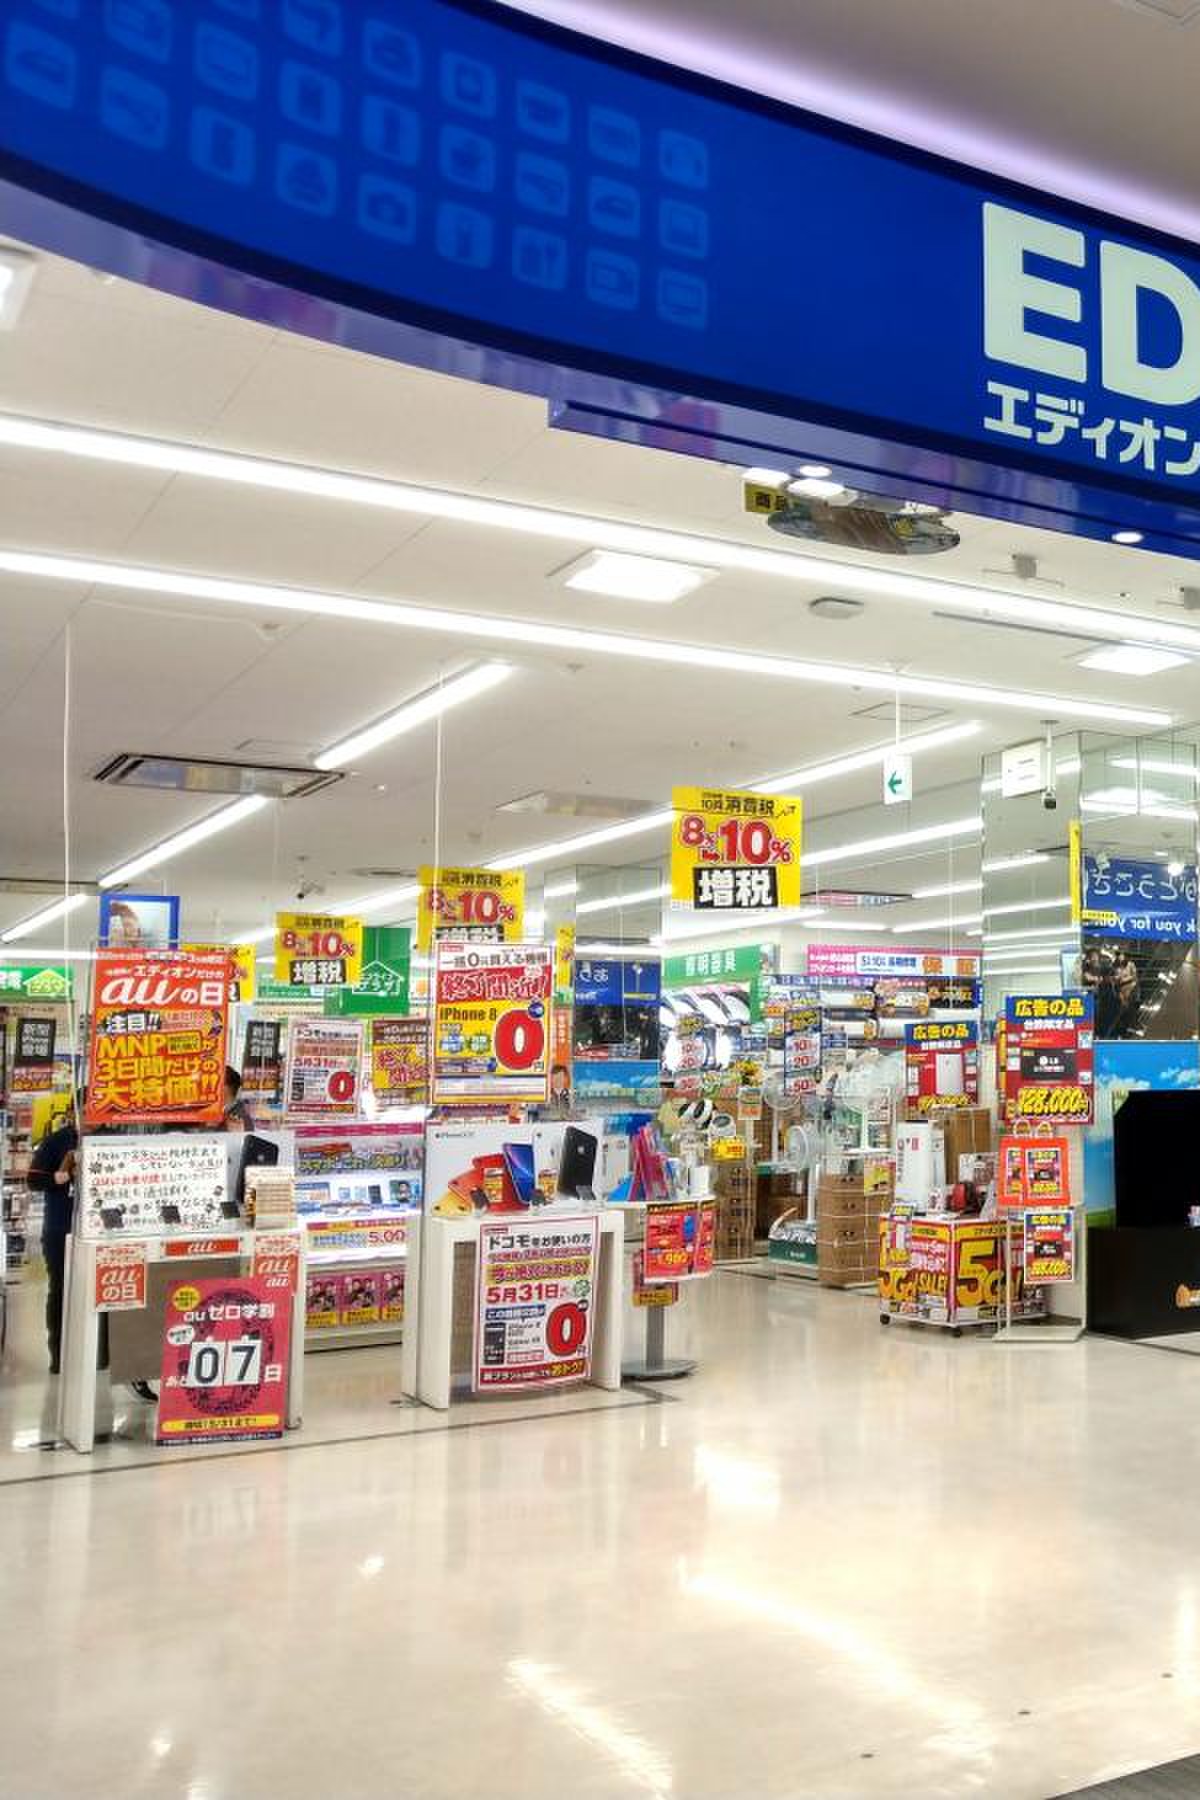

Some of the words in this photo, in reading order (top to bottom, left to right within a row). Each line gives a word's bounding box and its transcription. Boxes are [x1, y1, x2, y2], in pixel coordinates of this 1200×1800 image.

[698, 869, 773, 907] 増税
[293, 961, 343, 983] 増税
[1015, 998, 1085, 1017] 広告の品
[97, 1035, 167, 1059] MNP
[101, 1269, 140, 1286] au
[101, 1284, 138, 1300] の日
[546, 1303, 586, 1357] 0
[264, 1364, 282, 1383] 日
